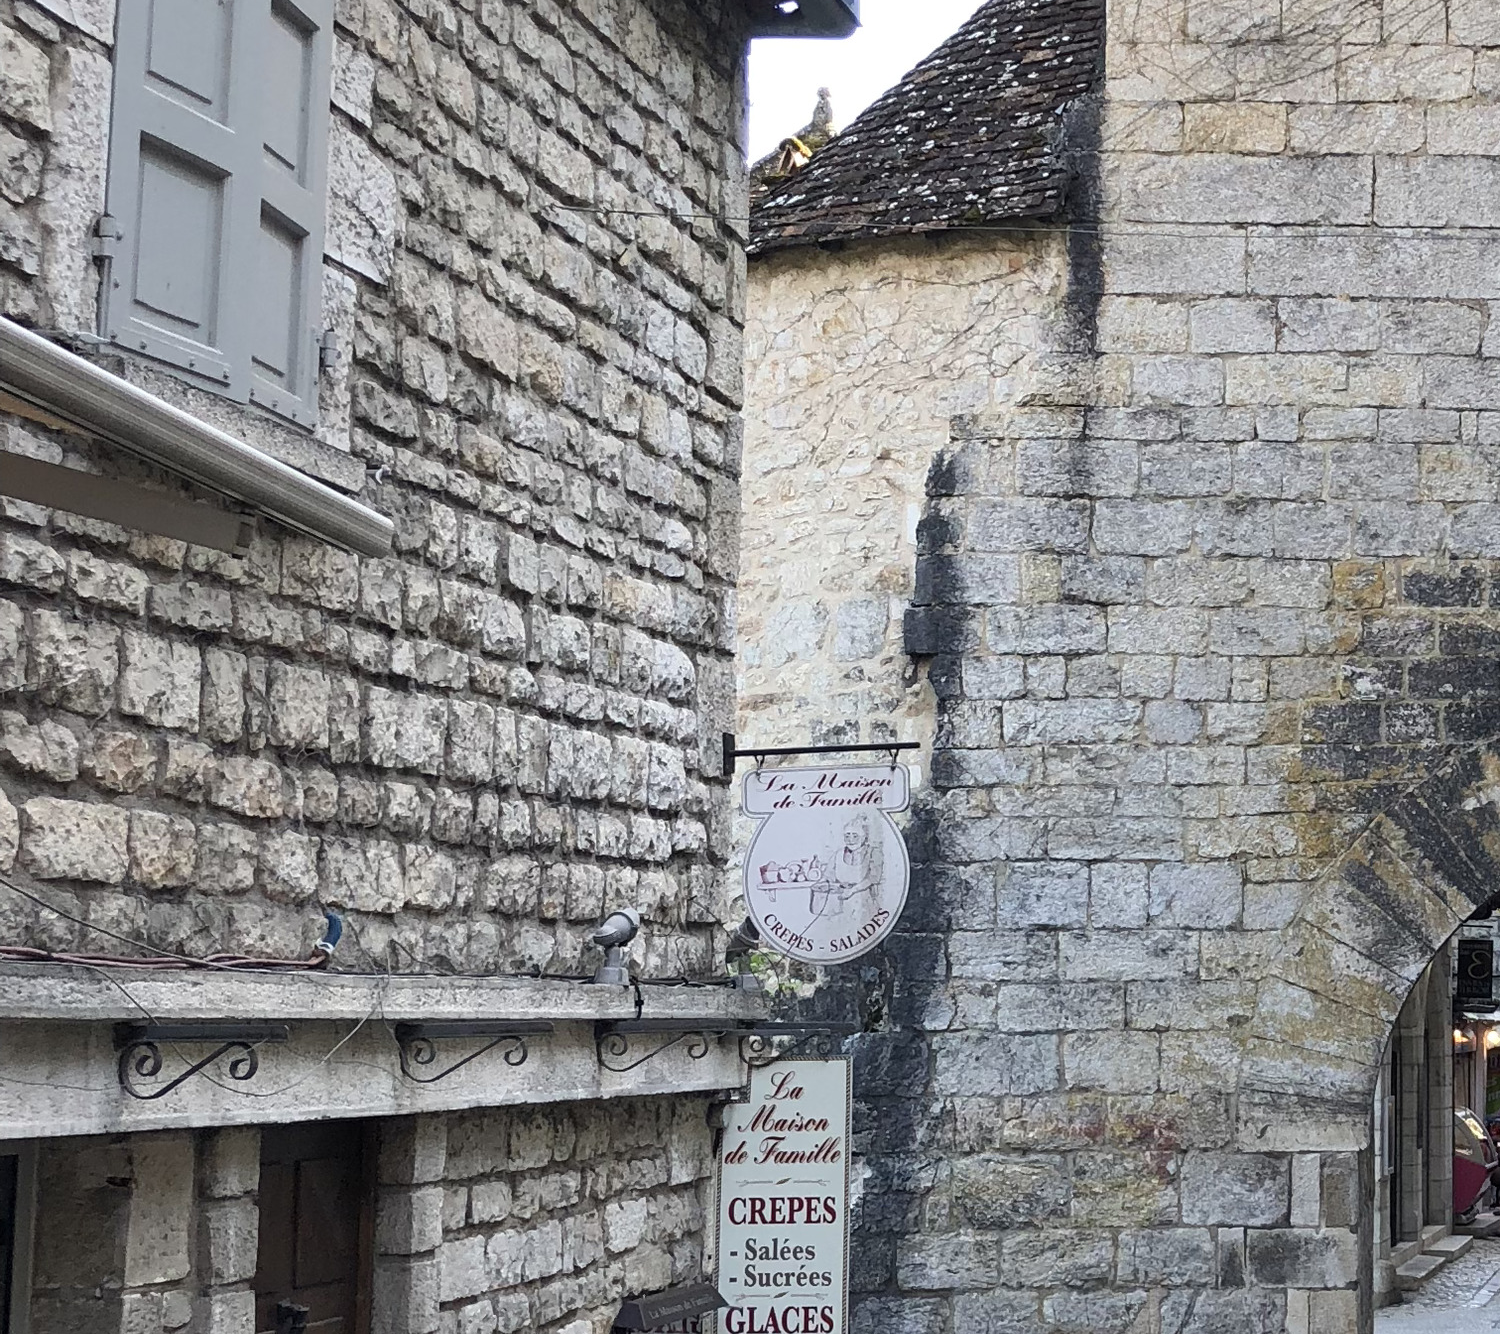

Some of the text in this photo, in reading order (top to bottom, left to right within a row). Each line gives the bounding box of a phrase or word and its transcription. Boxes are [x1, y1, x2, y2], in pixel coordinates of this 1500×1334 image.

[756, 772, 892, 792] La Maison
[773, 789, 883, 809] de Famille
[763, 907, 890, 953] CREPES SALADES
[764, 1070, 804, 1100] La
[737, 1104, 830, 1133] Maison
[724, 1136, 842, 1164] de Famille
[728, 1196, 837, 1225] CREPES
[744, 1237, 816, 1261] Salées
[744, 1264, 832, 1288] Sucrées
[725, 1306, 834, 1334] GLACES
